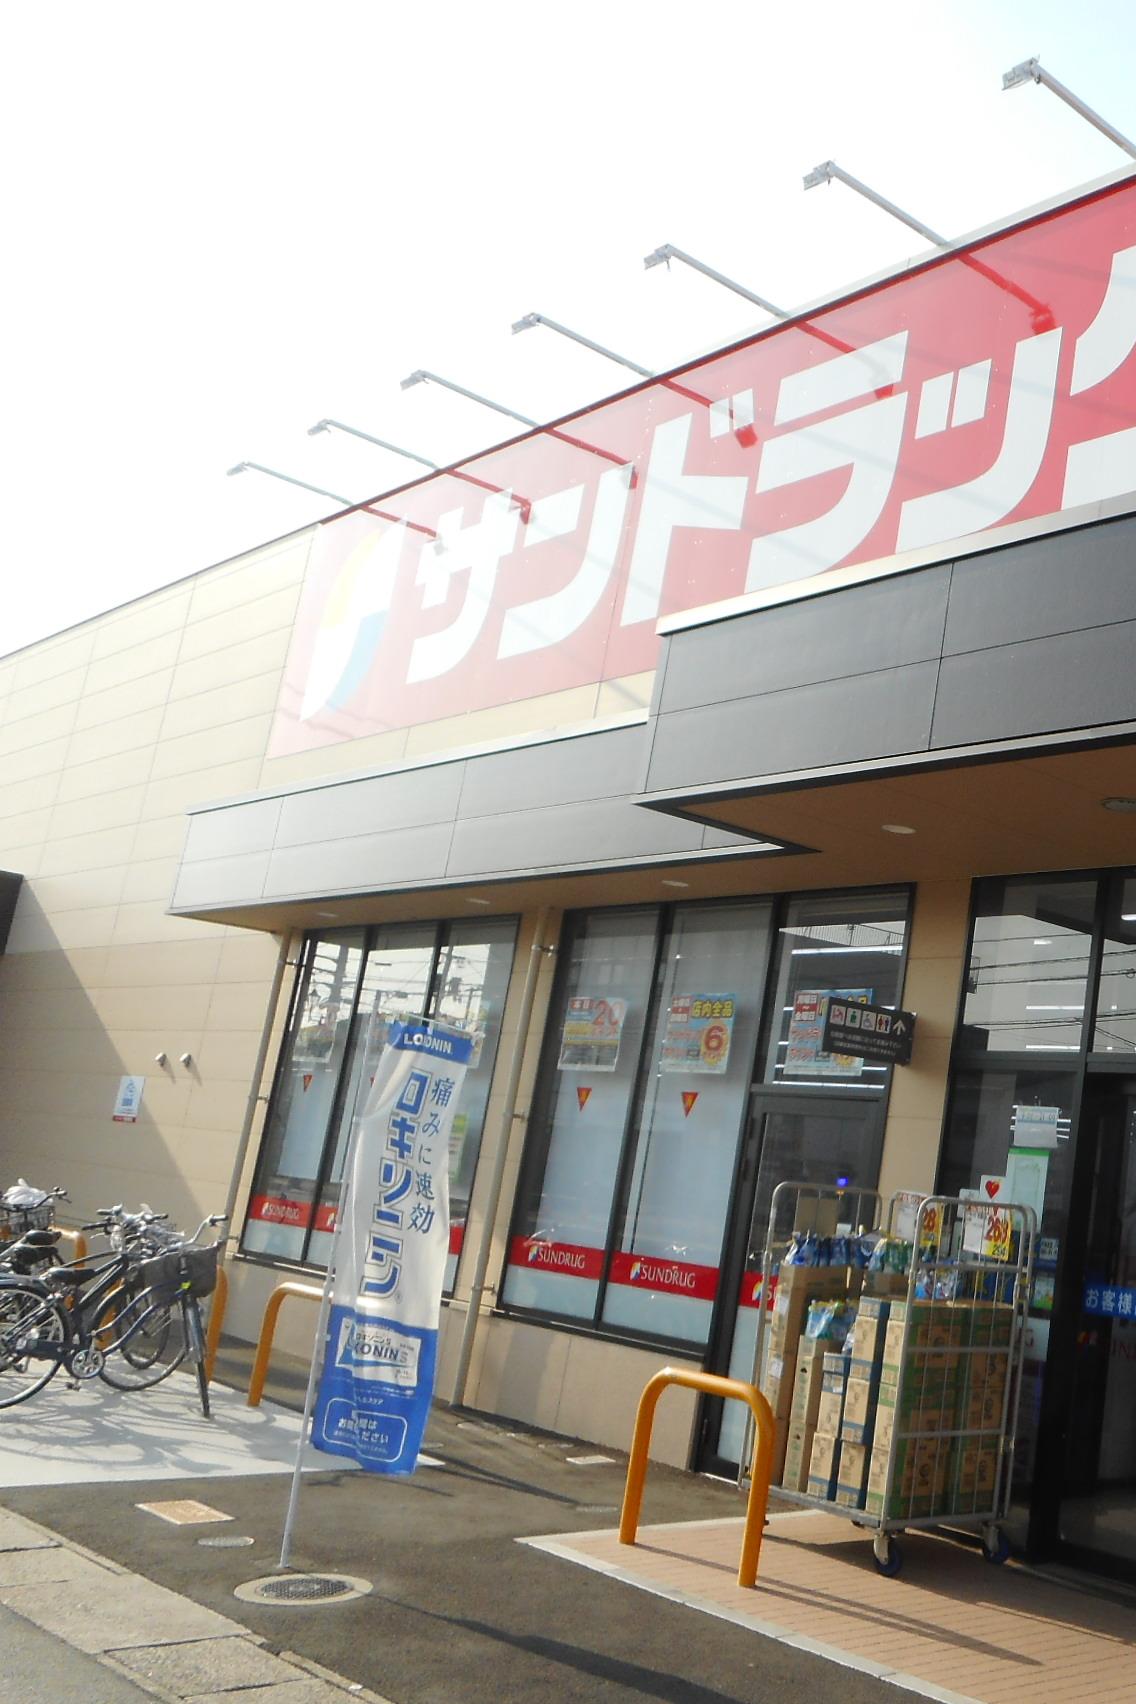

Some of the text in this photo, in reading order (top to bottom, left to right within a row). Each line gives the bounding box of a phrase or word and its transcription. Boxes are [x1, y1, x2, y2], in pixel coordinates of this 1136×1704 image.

[363, 1066, 433, 1298] ロキソニン
[407, 1076, 455, 1235] 痛みに速効
[537, 1247, 585, 1270] SUNDRUG
[640, 1264, 696, 1289] SUNDRUG
